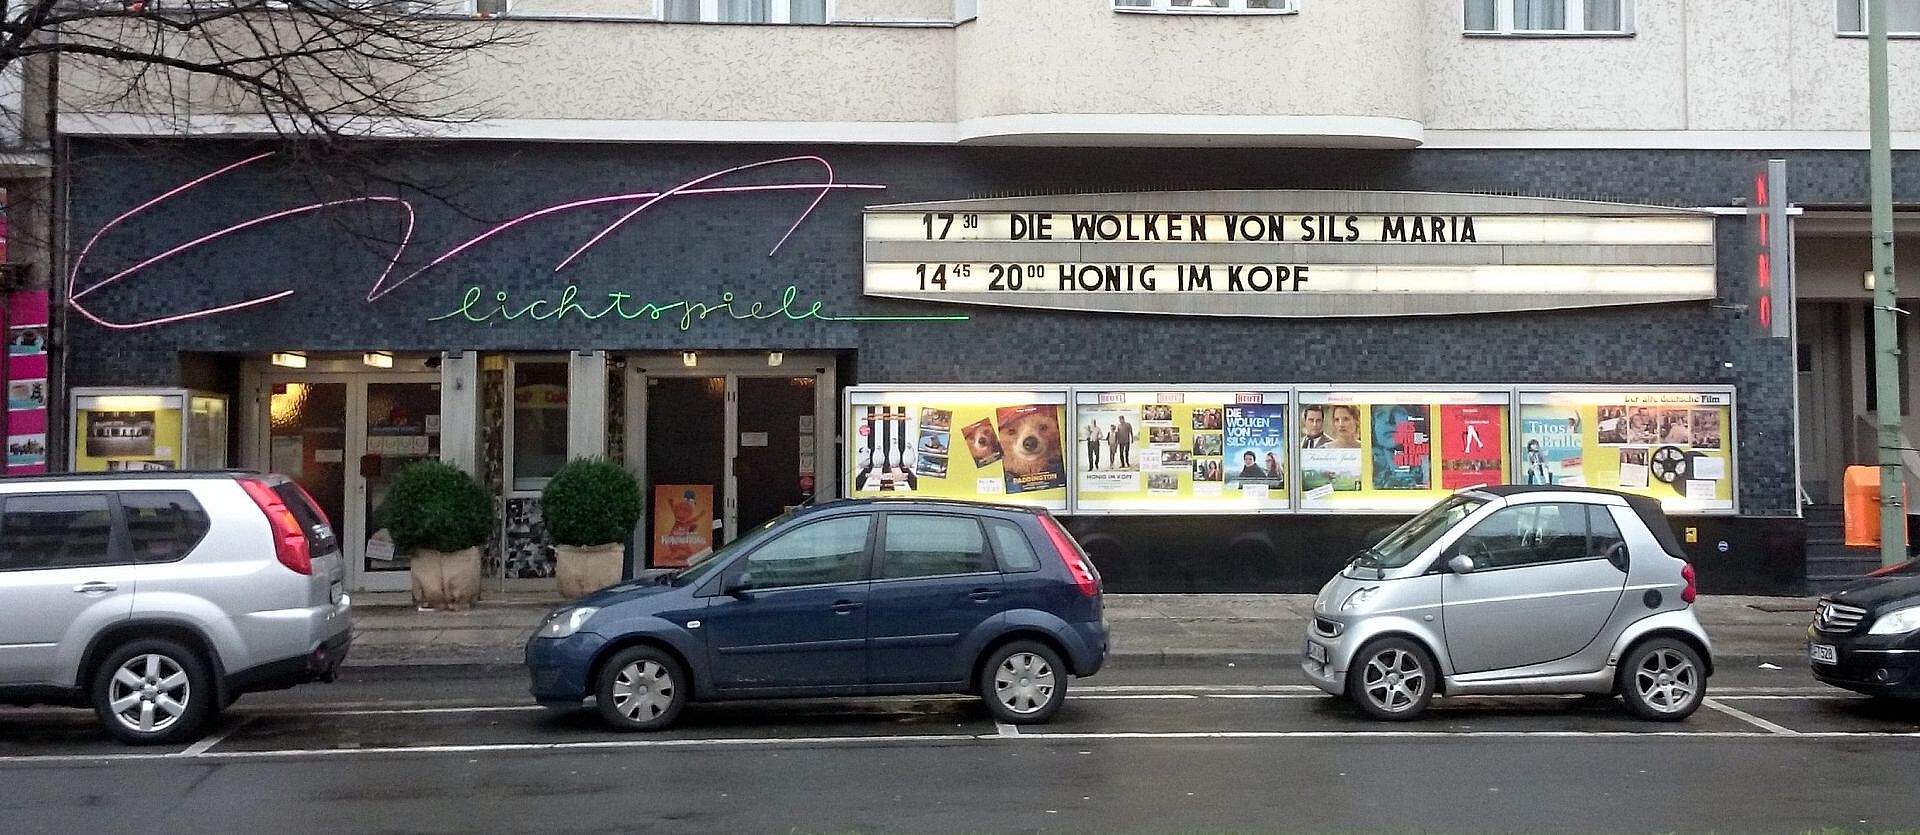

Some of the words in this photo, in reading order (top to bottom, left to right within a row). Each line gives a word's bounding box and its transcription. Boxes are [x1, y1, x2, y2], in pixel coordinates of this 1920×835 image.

[1010, 213, 1052, 240] DIE
[1072, 213, 1206, 241] WOLKEN
[1224, 215, 1284, 241] VON
[1301, 215, 1359, 242] SILS
[1381, 215, 1476, 242] MARIA
[1756, 175, 1770, 328] KINO
[1059, 265, 1155, 291] HONIG
[1178, 265, 1213, 291] IM
[1228, 265, 1309, 292] KOPF
[428, 286, 969, 330] lichtspiele
[1238, 394, 1261, 403] HEUTE
[1701, 395, 1720, 403] Film
[1226, 408, 1242, 417] DIE
[1226, 418, 1270, 427] WOLKEN
[1528, 420, 1566, 433] Titos
[1227, 427, 1251, 437] VON
[1227, 437, 1246, 446] SILS
[1248, 437, 1280, 446] MARIA
[1012, 473, 1057, 483] PADDINGTON
